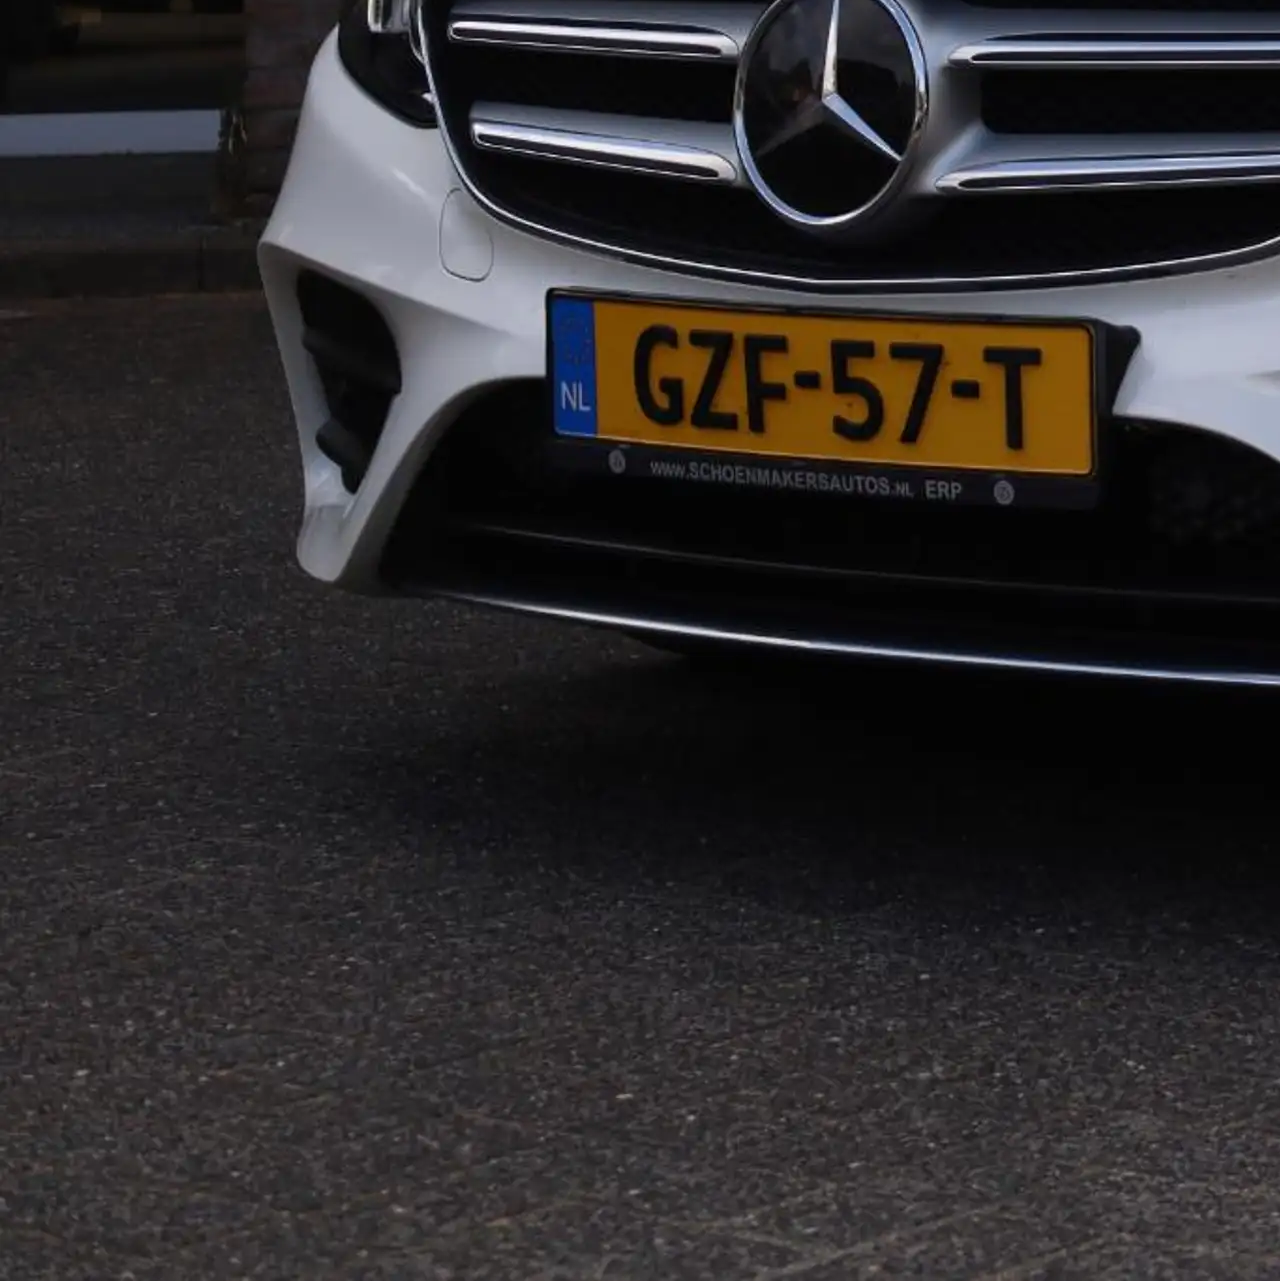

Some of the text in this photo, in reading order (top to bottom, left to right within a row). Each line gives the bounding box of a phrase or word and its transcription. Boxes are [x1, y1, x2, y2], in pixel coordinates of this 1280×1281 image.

[561, 381, 591, 412] NL
[634, 324, 1042, 450] GZF-57-T
[924, 478, 963, 501] ERP
